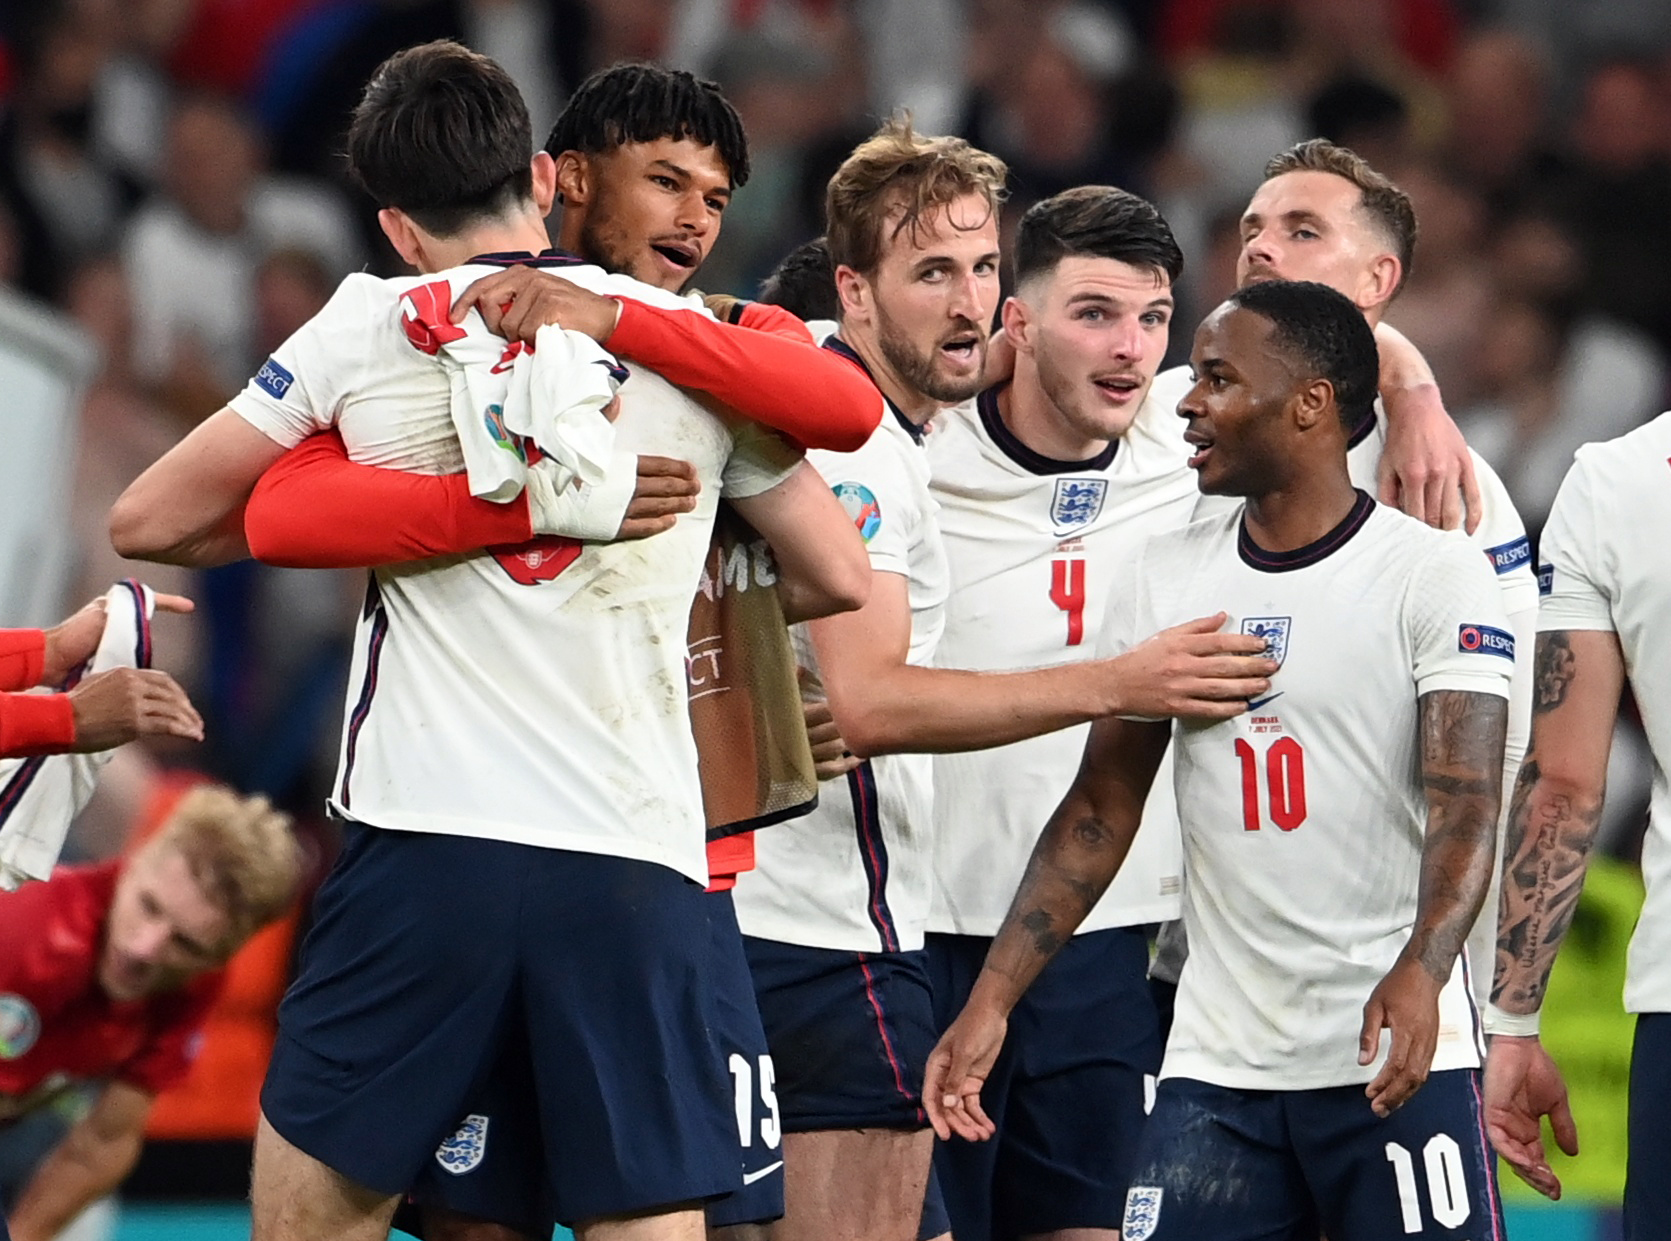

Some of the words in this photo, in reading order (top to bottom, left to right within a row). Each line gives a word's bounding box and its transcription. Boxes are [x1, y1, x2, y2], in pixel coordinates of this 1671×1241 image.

[1496, 541, 1530, 567] RESPECT
[1048, 559, 1085, 646] 4
[1234, 736, 1307, 832] 10
[728, 1053, 781, 1149] 15
[1385, 1133, 1471, 1234] 10
